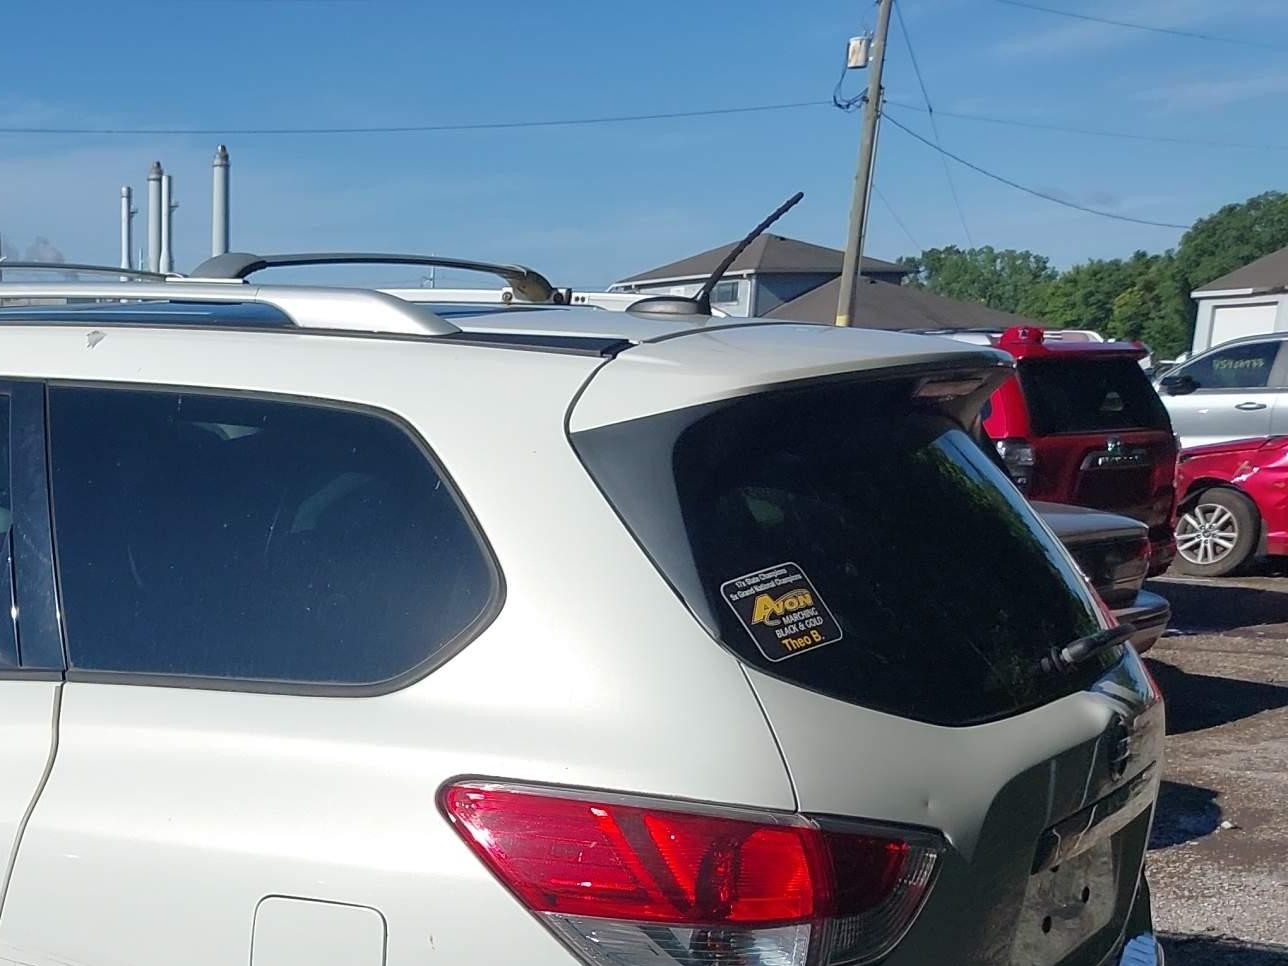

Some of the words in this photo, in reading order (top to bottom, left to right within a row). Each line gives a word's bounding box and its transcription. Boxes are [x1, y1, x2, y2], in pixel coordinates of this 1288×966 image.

[775, 623, 797, 639] BLACK
[798, 622, 806, 631] &
[805, 616, 824, 629] GOLD
[782, 607, 819, 625] MARCHING
[781, 635, 812, 652] Theo
[810, 629, 826, 642] B.
